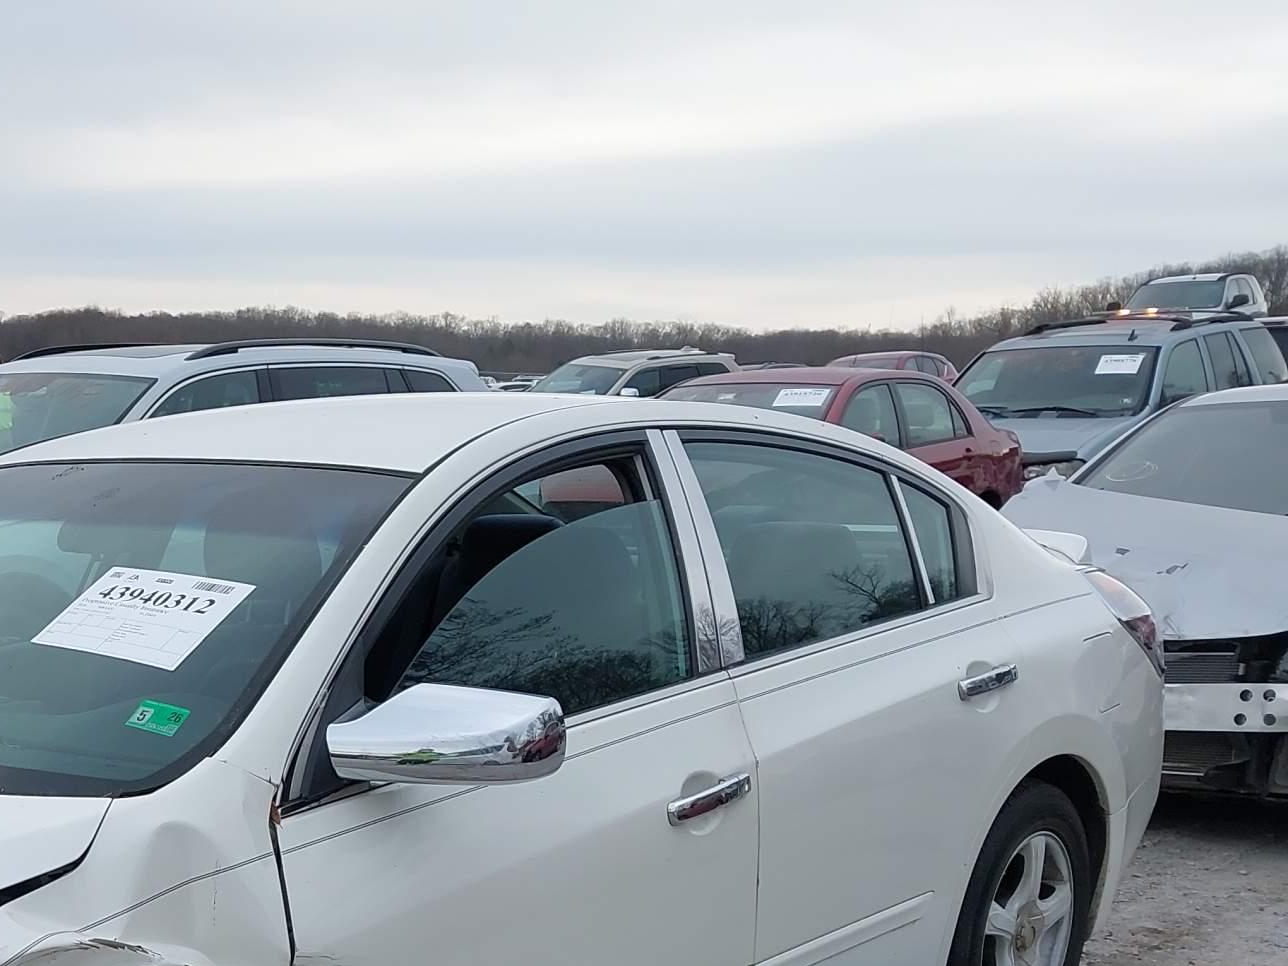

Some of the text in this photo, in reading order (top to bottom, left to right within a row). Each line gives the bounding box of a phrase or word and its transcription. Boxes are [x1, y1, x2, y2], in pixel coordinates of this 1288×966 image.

[99, 585, 216, 614] 43940312
[137, 710, 184, 723] 5 26
